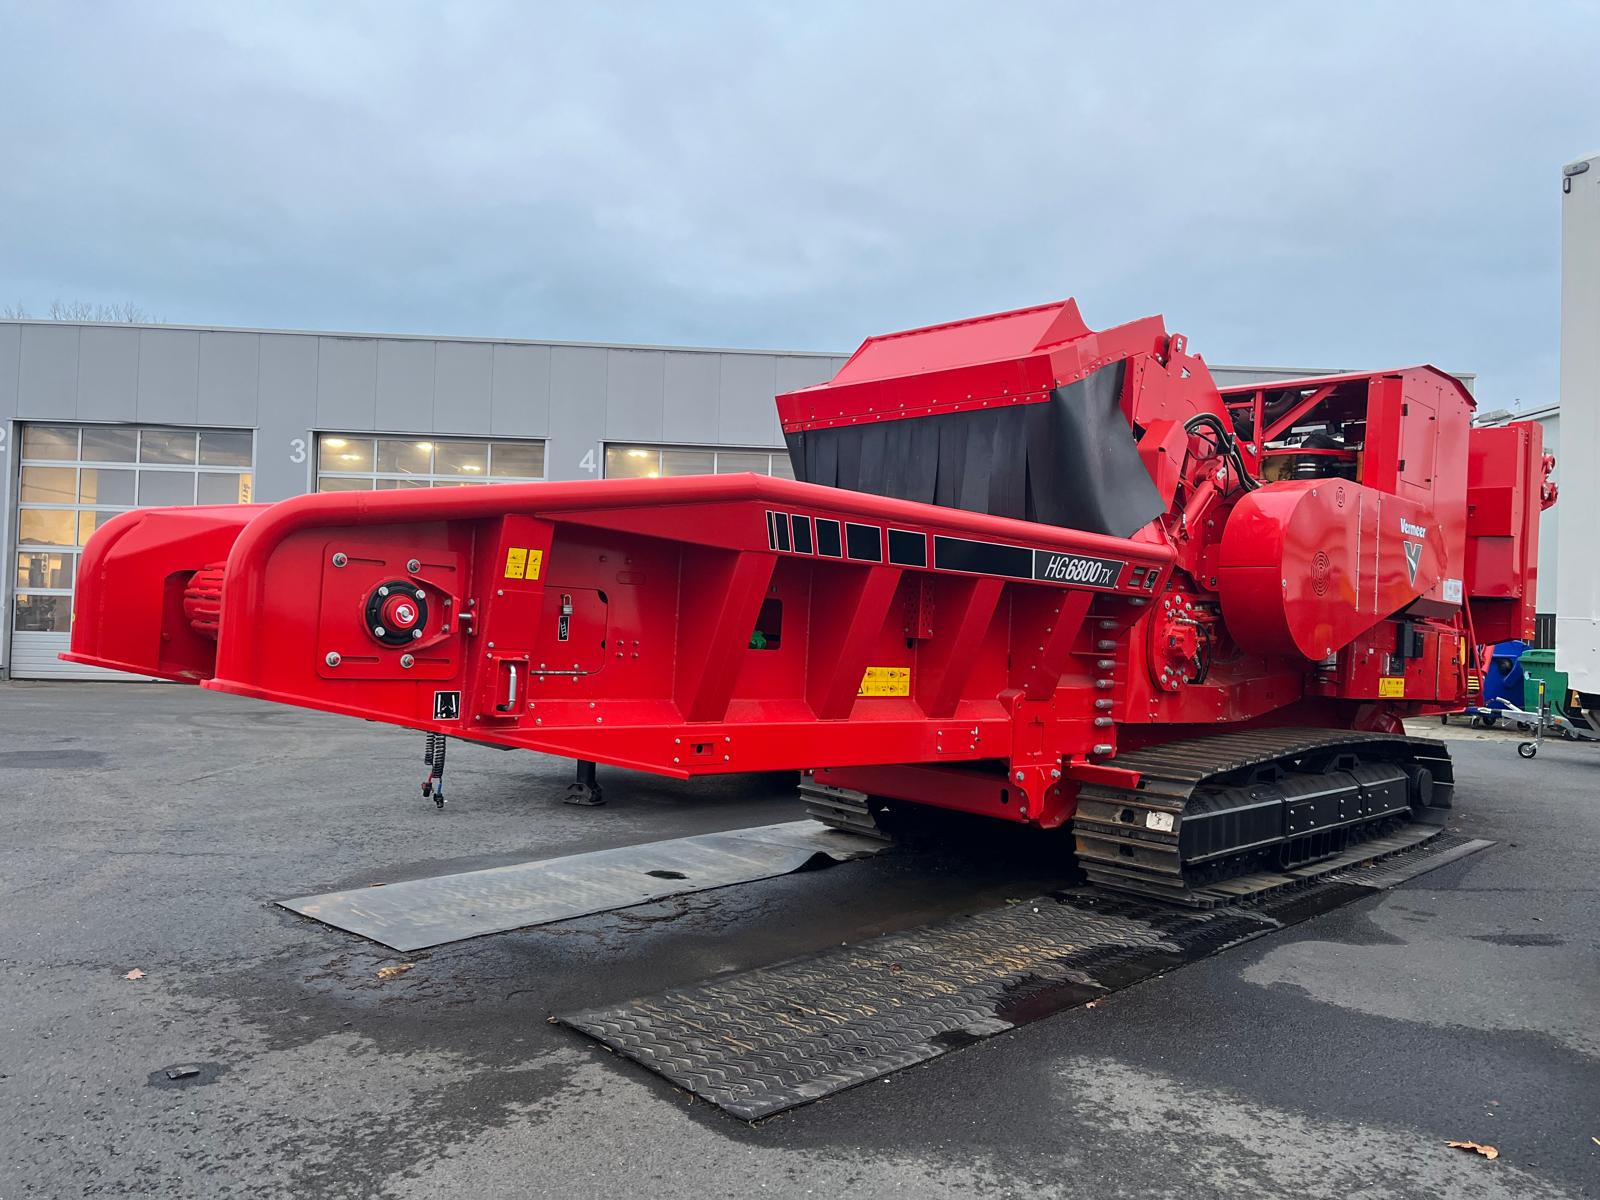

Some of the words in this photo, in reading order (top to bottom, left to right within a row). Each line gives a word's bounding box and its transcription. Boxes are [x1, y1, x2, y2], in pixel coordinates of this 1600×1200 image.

[290, 438, 306, 463] 3
[579, 449, 596, 473] 4
[1400, 517, 1426, 538] Vermeer
